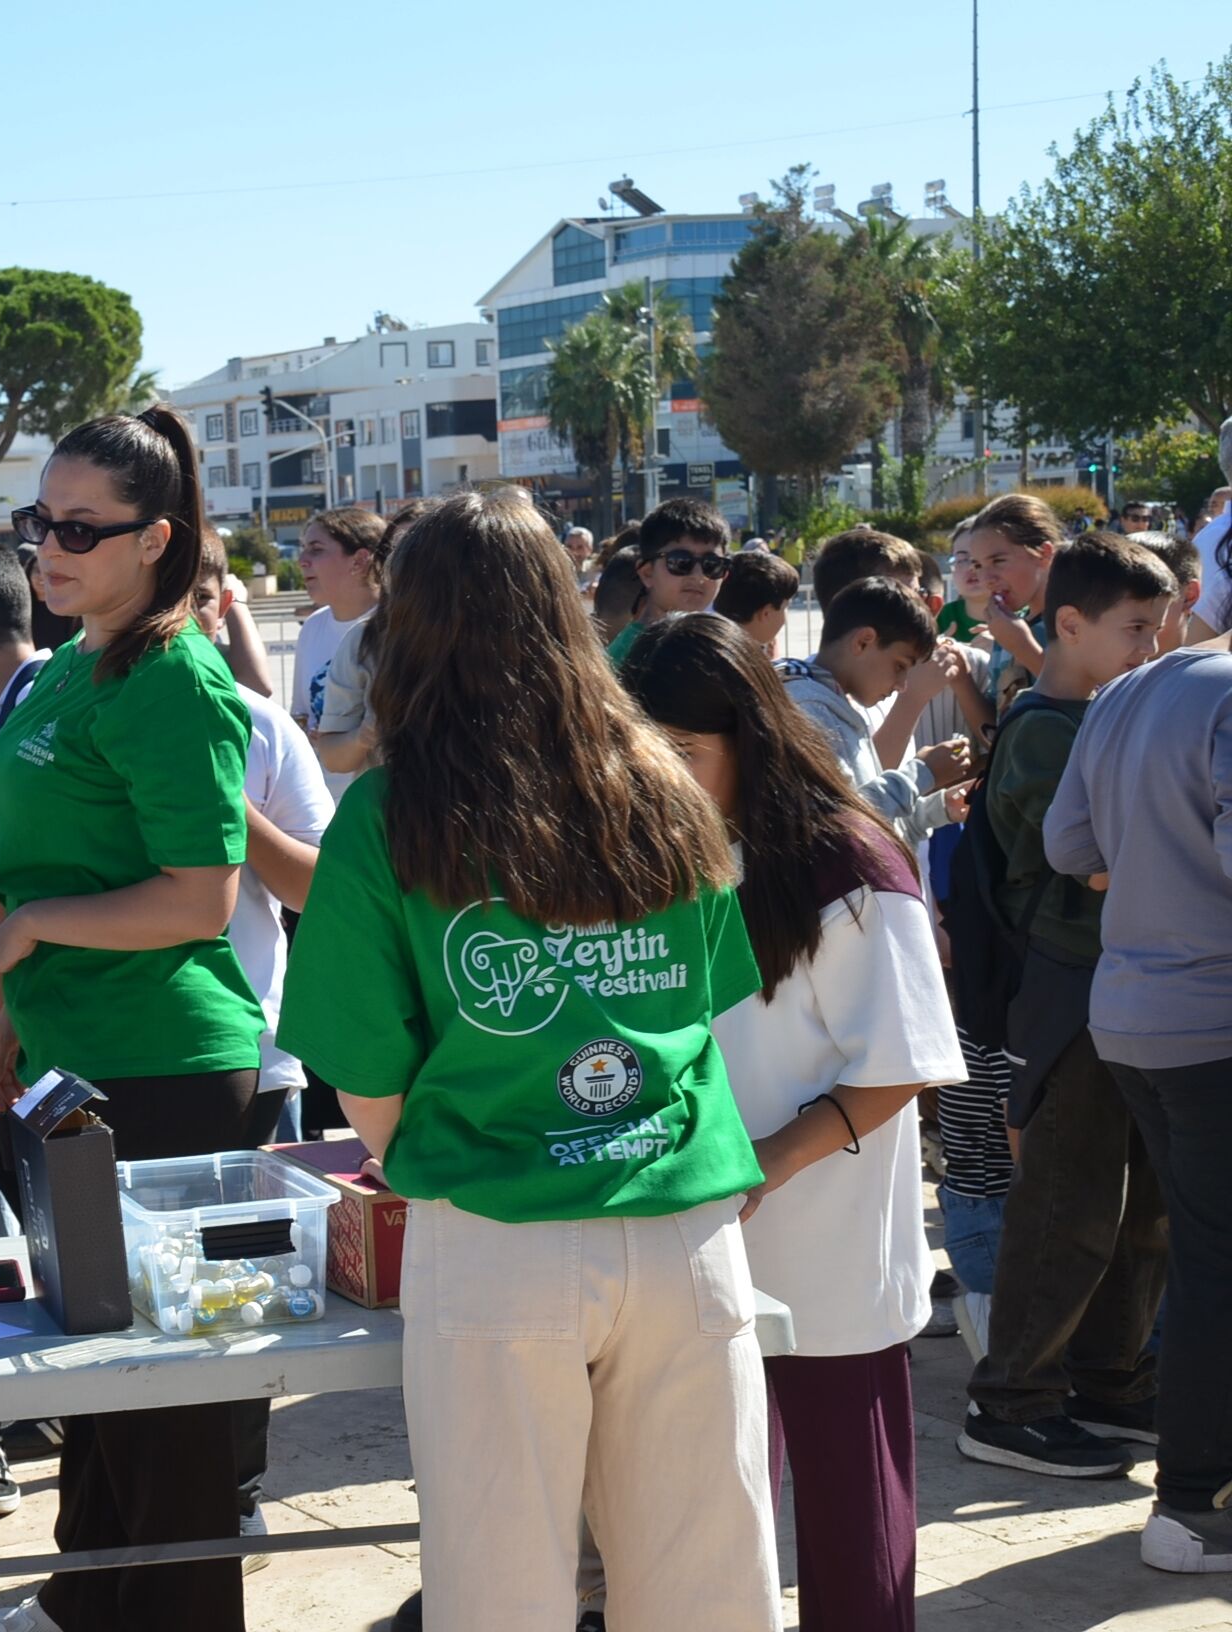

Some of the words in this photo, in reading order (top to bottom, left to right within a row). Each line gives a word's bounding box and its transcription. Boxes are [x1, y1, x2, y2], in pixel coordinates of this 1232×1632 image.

[542, 925, 669, 976] Zeytin
[574, 963, 688, 998] Festivali
[569, 1042, 631, 1067] GUINNESS
[560, 1074, 591, 1112] WORLD
[594, 1067, 639, 1114] RECORDS
[549, 1115, 669, 1157] OFFICIAL
[559, 1138, 669, 1167] ATTEMPT
[382, 1209, 406, 1227] VA
